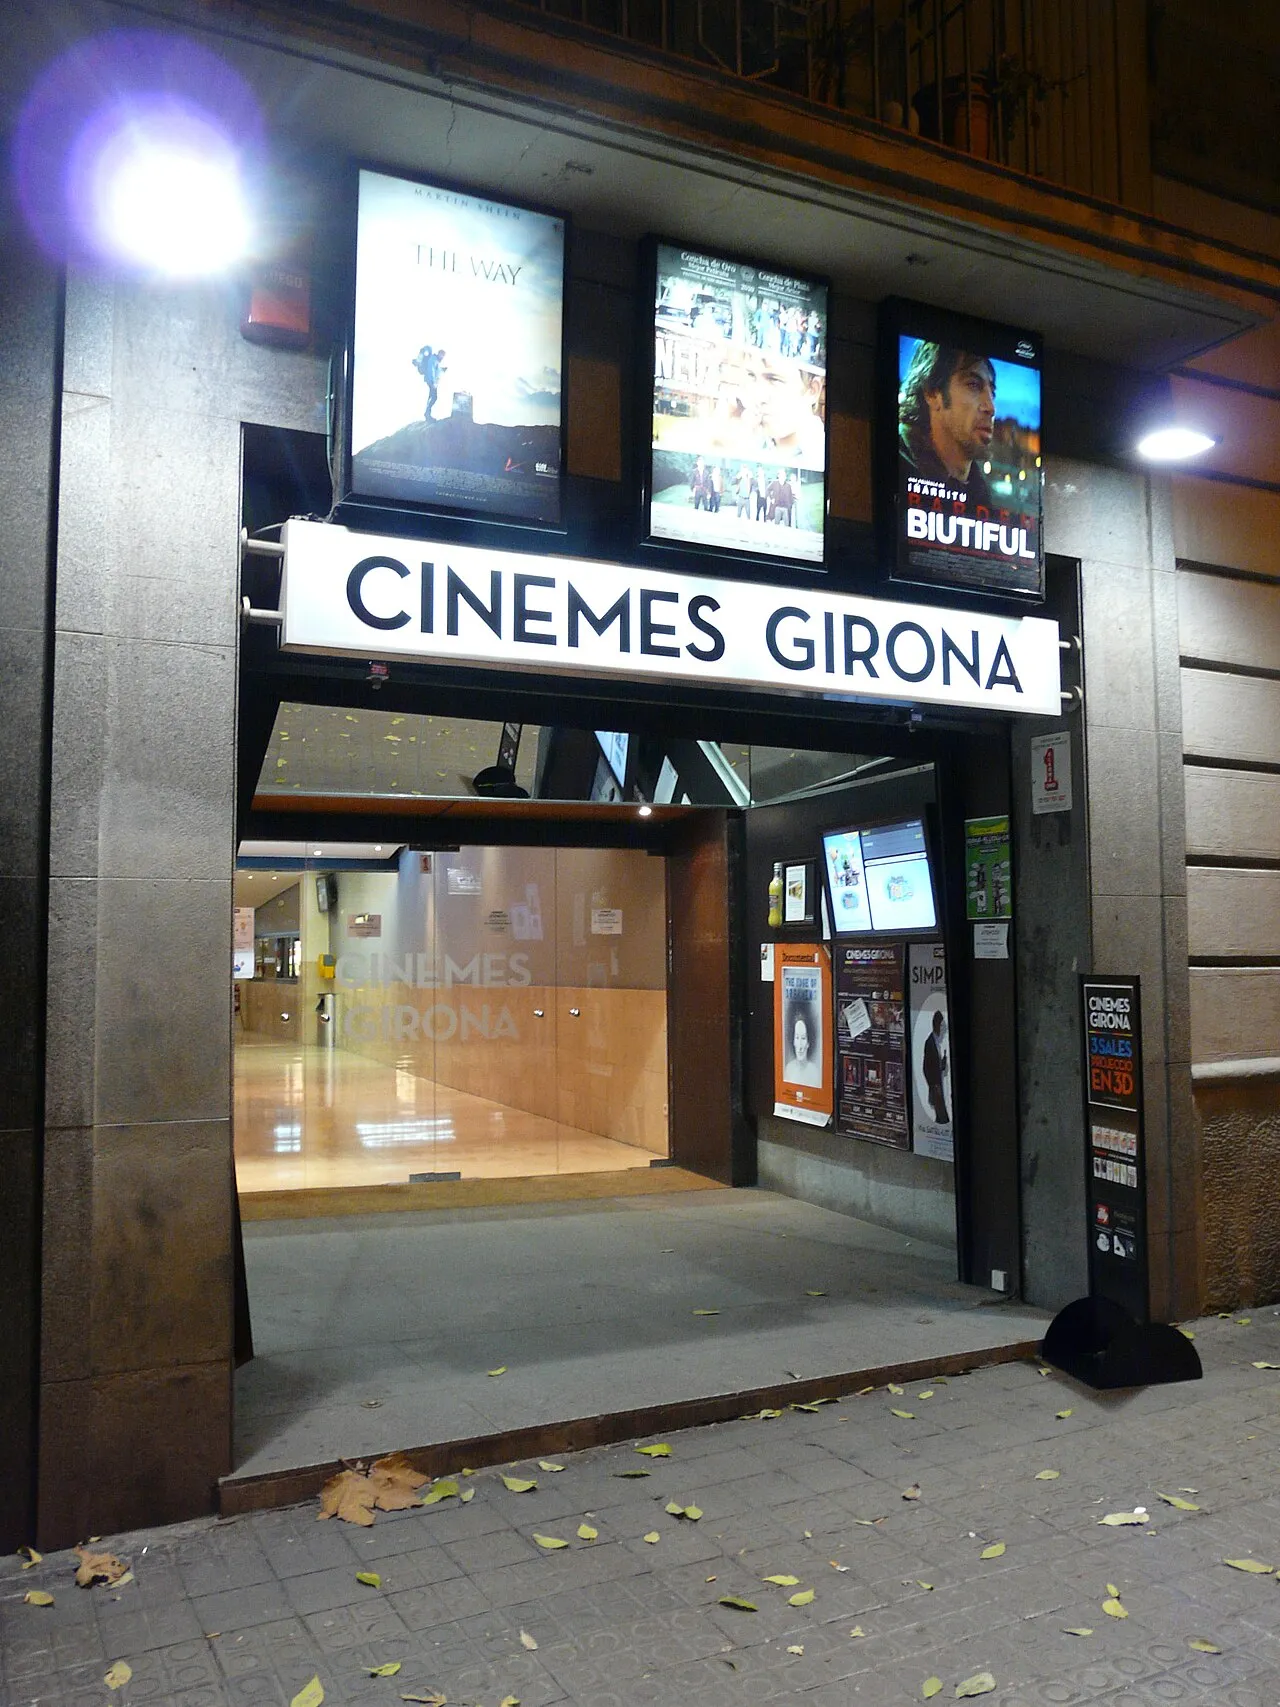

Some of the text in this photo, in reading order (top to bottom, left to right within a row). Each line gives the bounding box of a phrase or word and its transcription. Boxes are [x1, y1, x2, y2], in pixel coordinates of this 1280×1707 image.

[470, 255, 523, 286] WAY
[907, 507, 1036, 559] BIUTIFUL
[347, 556, 1024, 694] CINEMES GIRONA
[335, 951, 532, 990] CINEMES
[1088, 996, 1131, 1013] CINEMES
[344, 1003, 521, 1044] GIRONA
[1089, 1011, 1132, 1031] GIRONA
[1098, 1037, 1133, 1058] SALES
[1113, 1070, 1134, 1096] 3D
